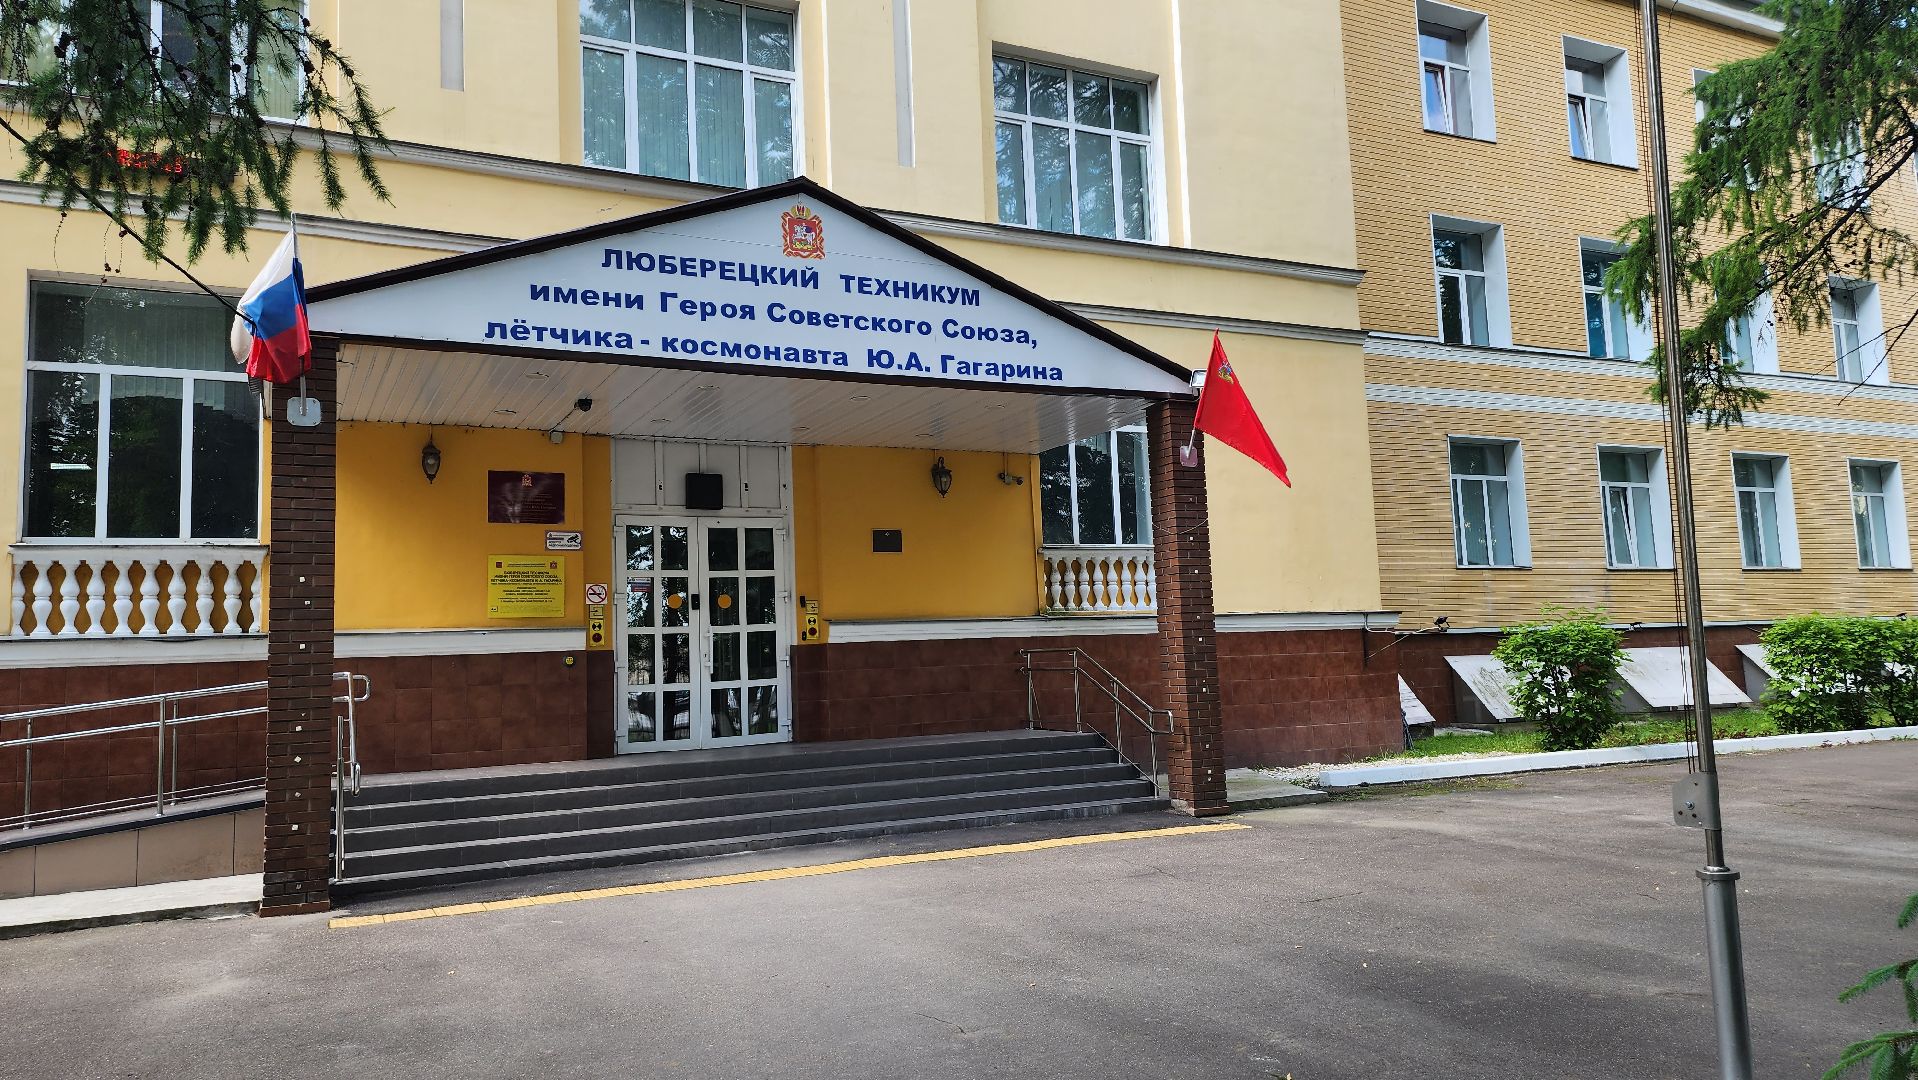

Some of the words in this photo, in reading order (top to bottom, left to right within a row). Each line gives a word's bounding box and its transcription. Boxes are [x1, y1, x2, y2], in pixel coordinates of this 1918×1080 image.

[602, 248, 819, 290] ЛЮБЕРЕЦКИЙ
[839, 273, 980, 307] ТЕХНИКУМ
[529, 283, 644, 311] имени
[659, 291, 756, 322] Героя
[766, 302, 933, 336] Советского
[941, 318, 1038, 350] Союза,
[867, 348, 931, 373] Ю.А.
[940, 354, 1064, 382] Гагарина
